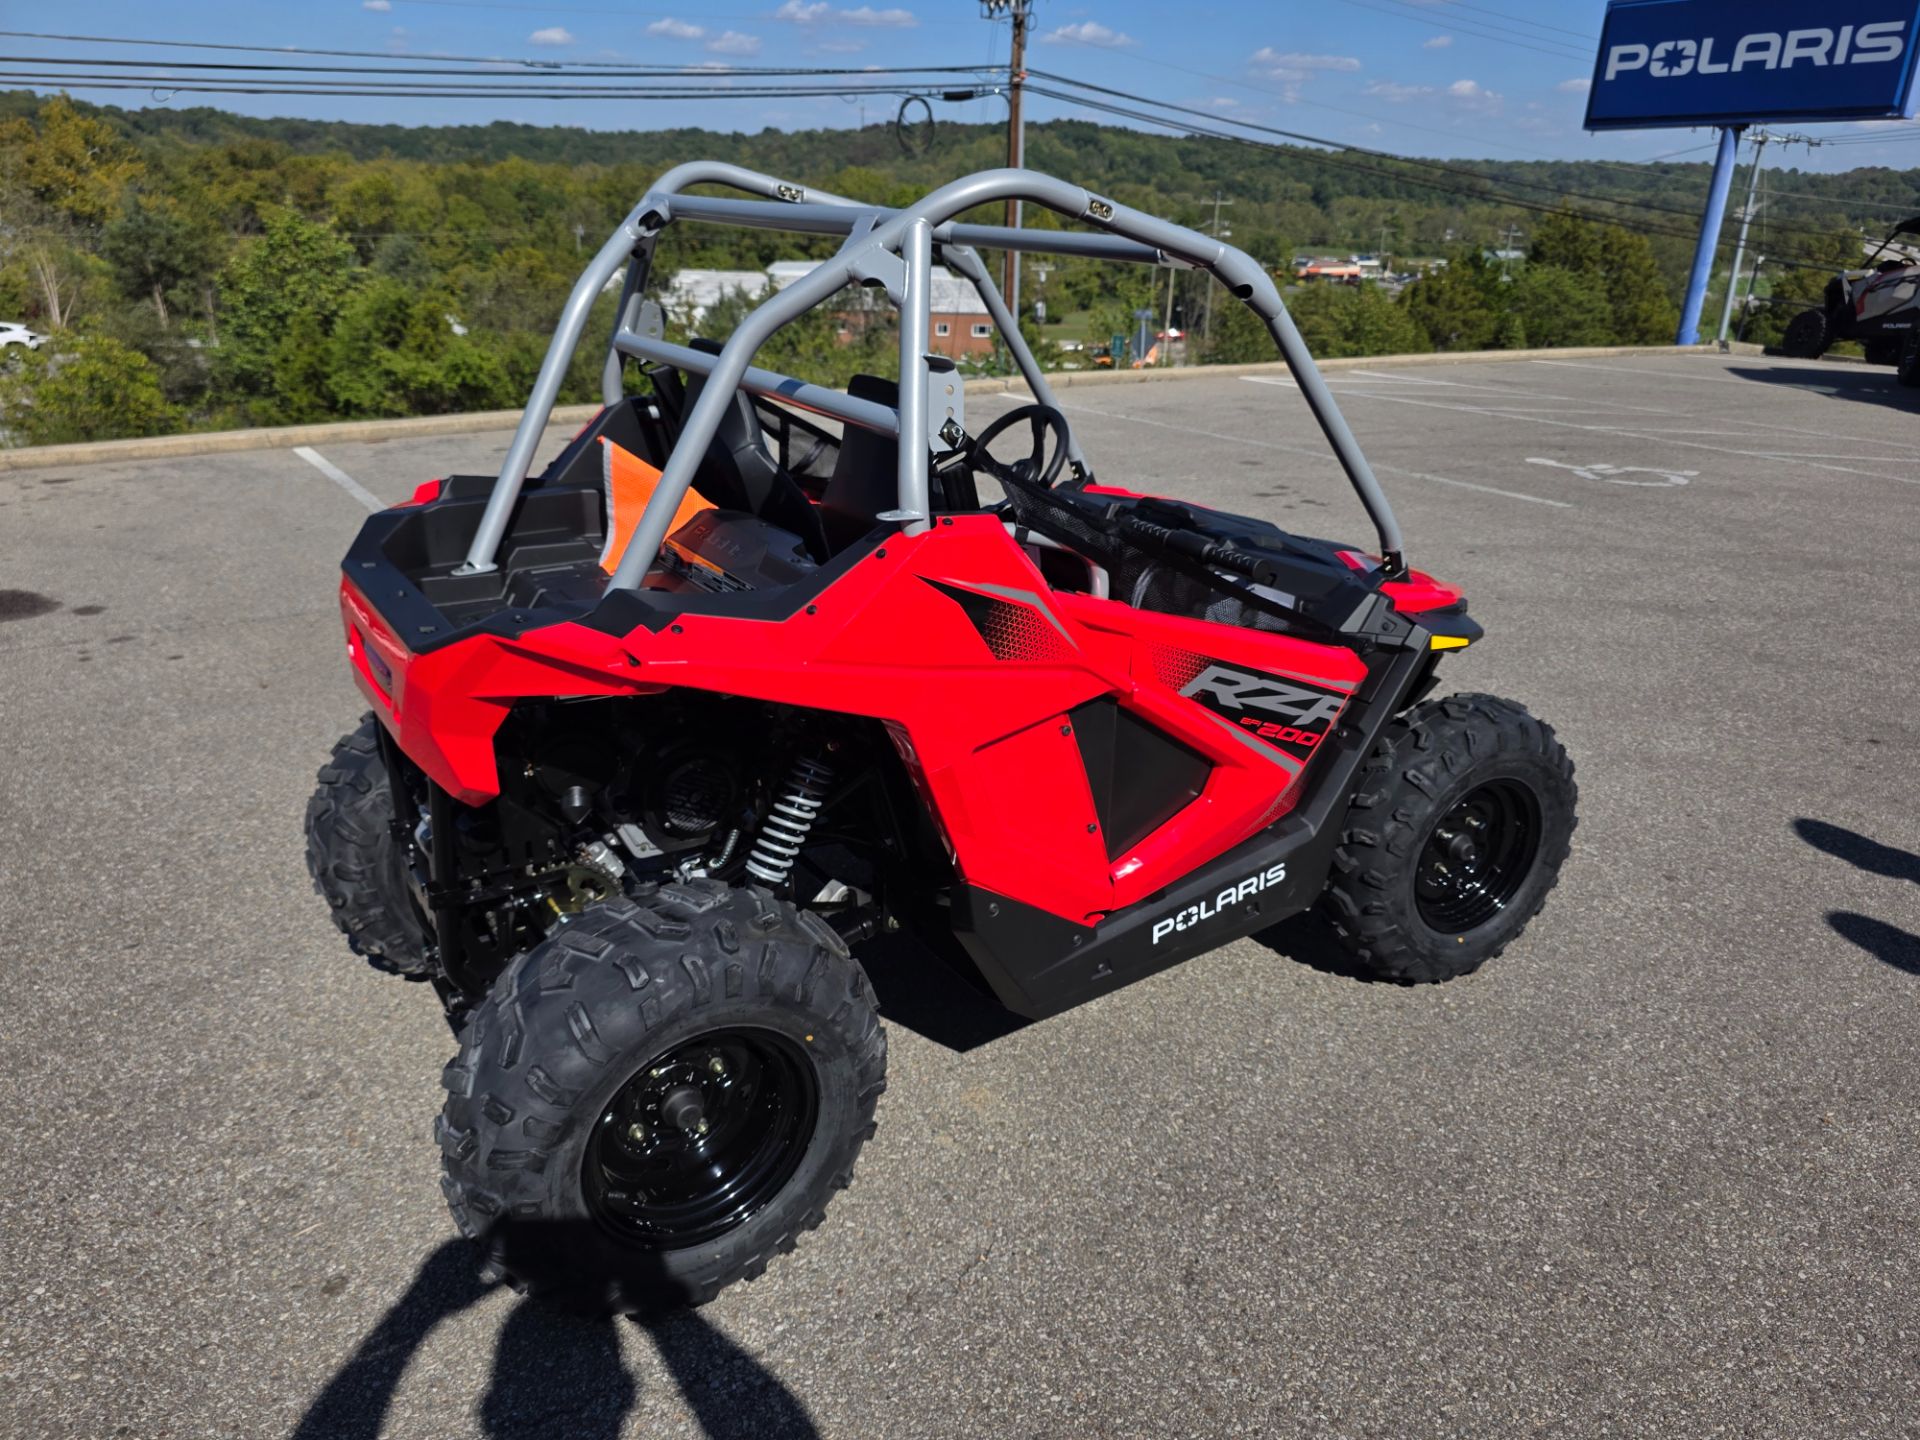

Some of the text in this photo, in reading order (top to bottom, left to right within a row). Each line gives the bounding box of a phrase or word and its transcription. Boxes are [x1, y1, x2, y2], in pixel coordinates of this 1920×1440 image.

[1604, 21, 1905, 80] POLARIS
[1257, 723, 1321, 747] 200
[1153, 863, 1286, 945] POLARIS
